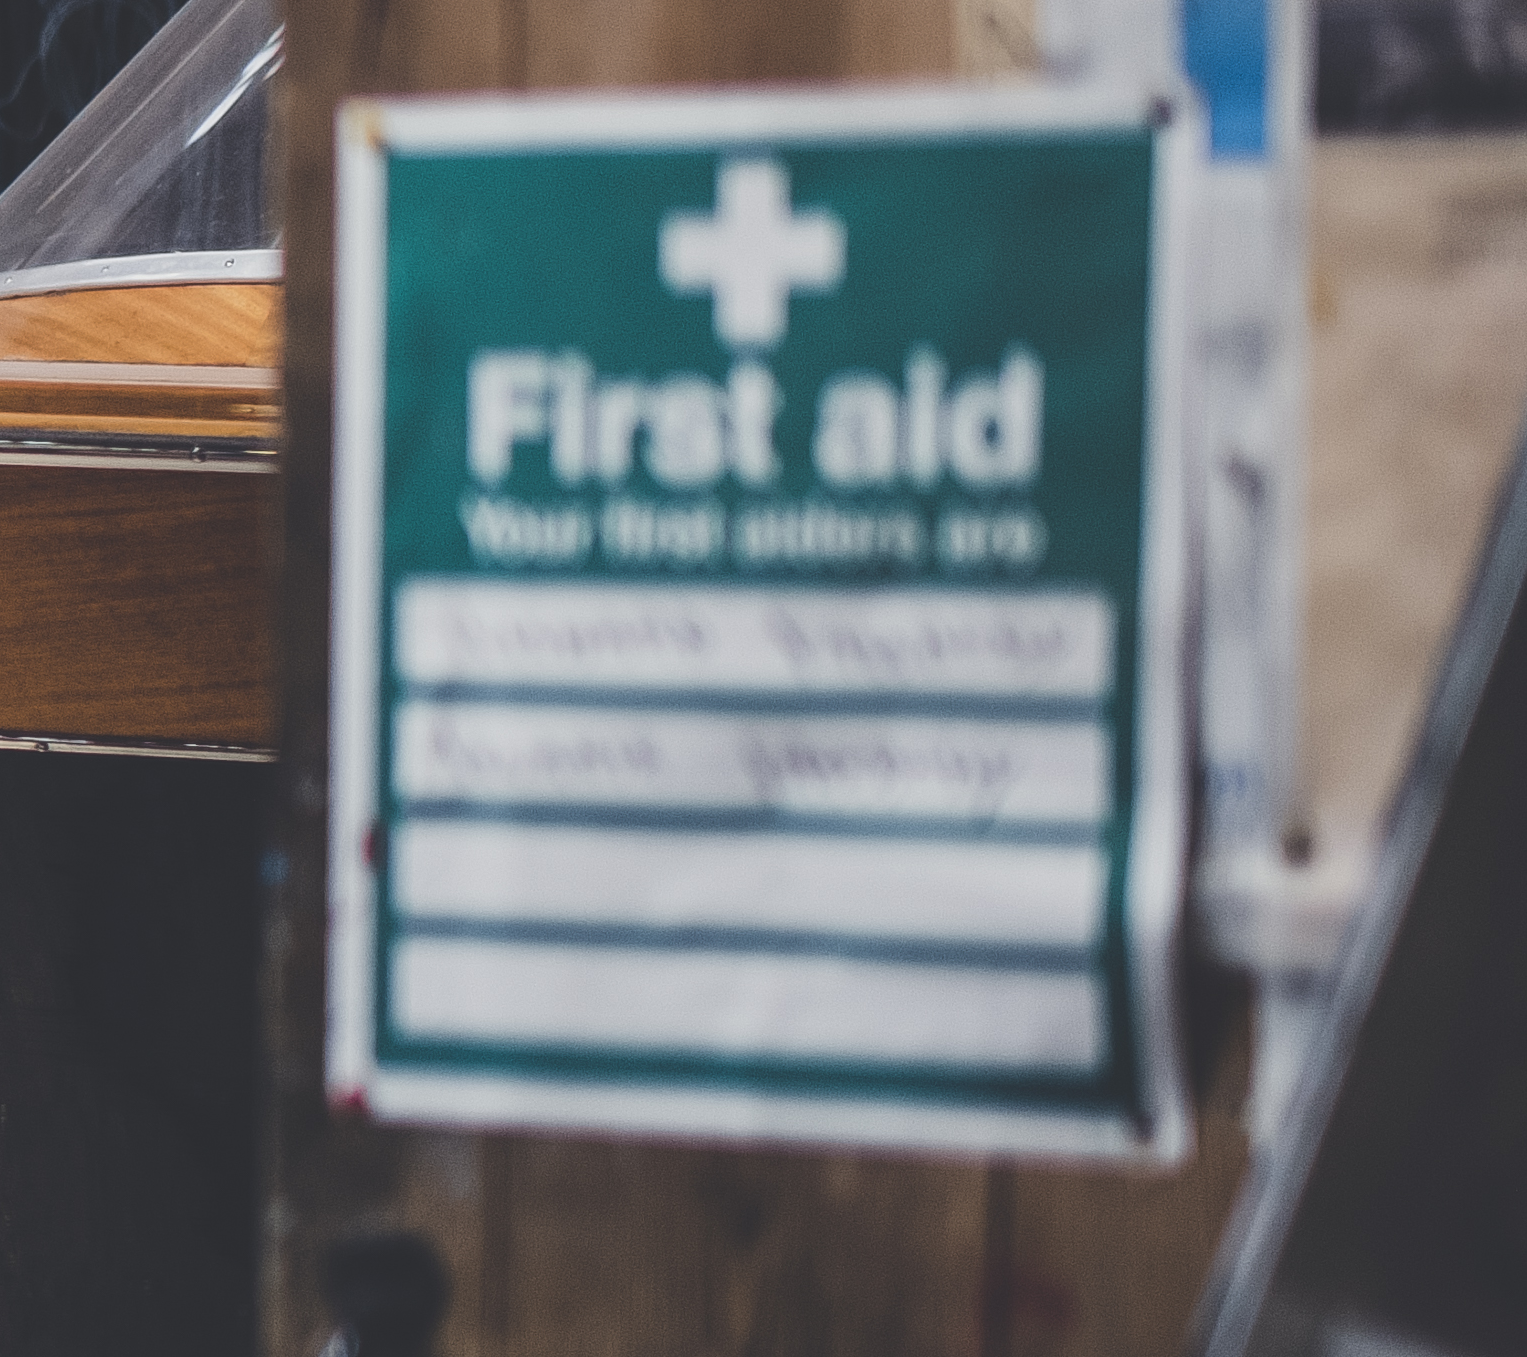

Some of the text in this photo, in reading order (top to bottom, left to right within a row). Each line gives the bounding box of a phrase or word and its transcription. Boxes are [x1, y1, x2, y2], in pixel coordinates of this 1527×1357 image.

[465, 342, 1046, 490] First aid
[462, 494, 592, 568] Your
[606, 494, 724, 562] first
[942, 510, 1042, 563] are
